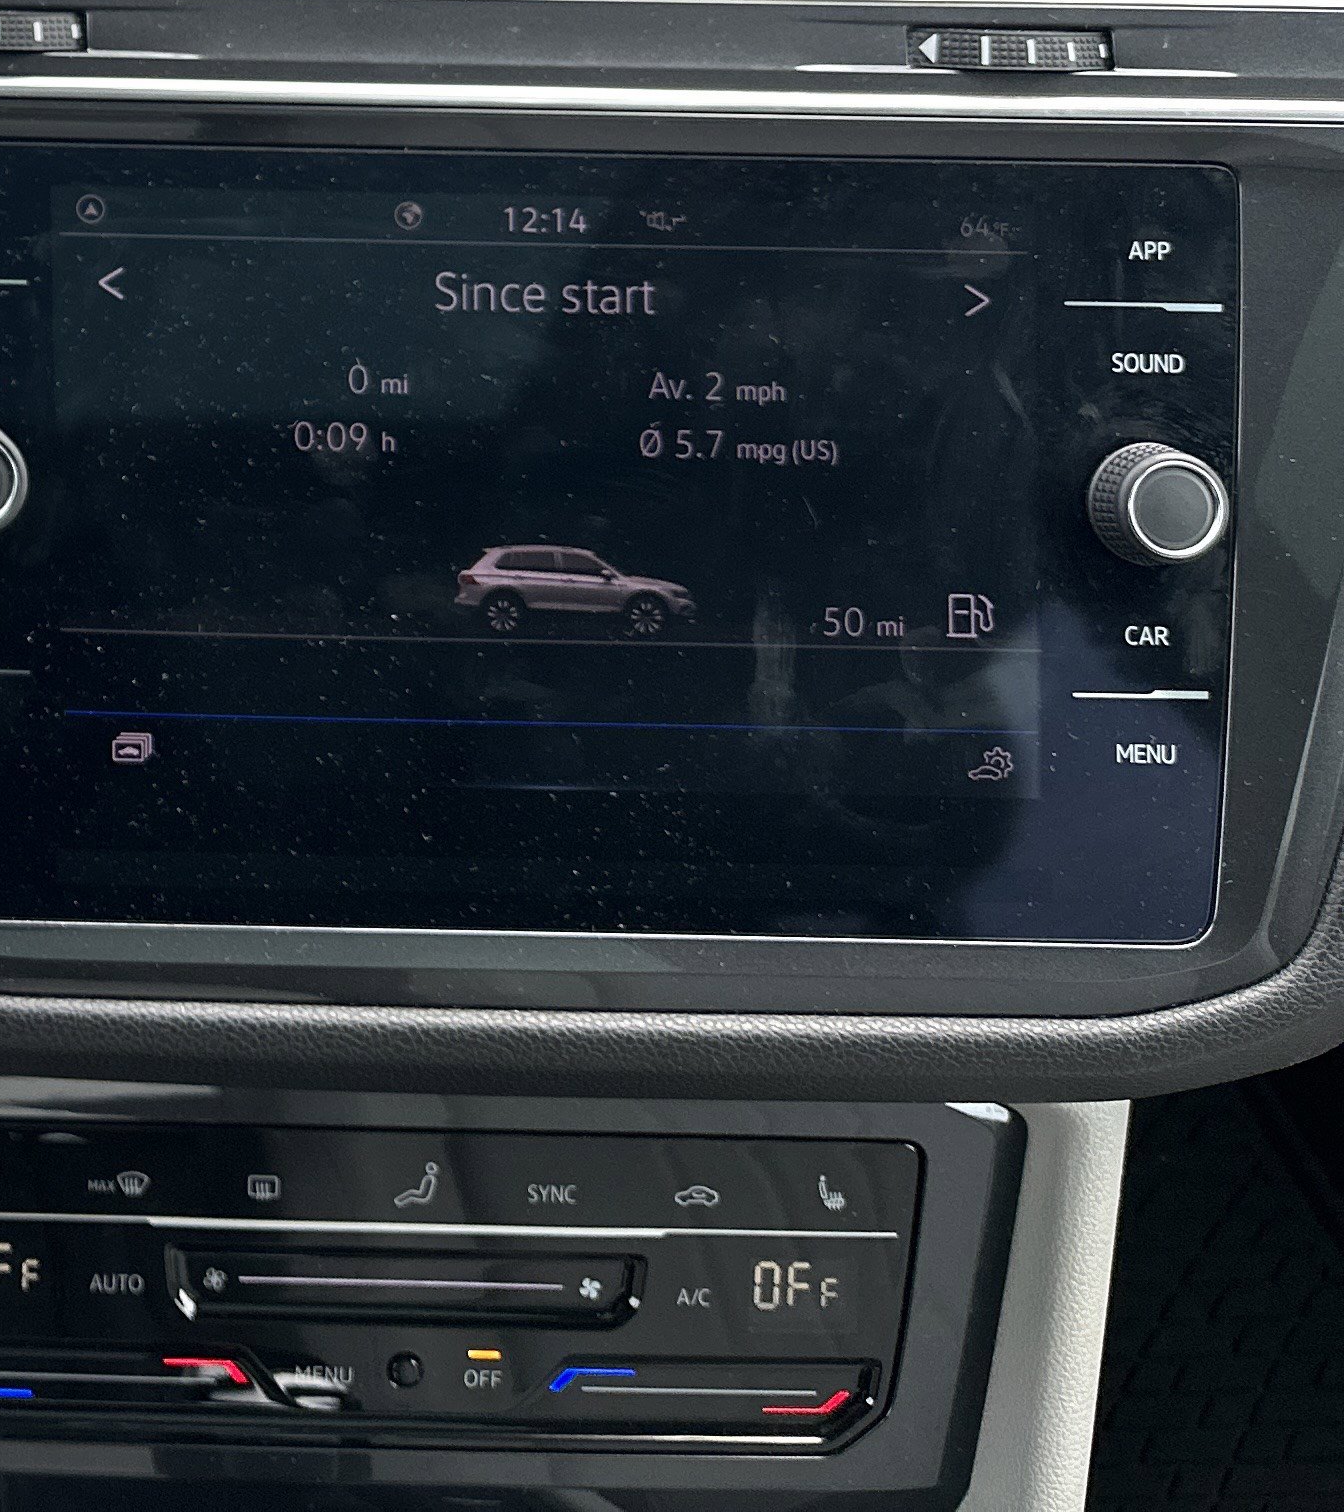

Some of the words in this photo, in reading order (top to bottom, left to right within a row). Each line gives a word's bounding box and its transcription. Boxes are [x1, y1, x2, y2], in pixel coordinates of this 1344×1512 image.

[504, 205, 589, 234] 12:14
[1128, 240, 1173, 261] APP
[434, 271, 546, 313] Since
[560, 279, 659, 316] start
[1111, 351, 1187, 375] SOUND
[348, 364, 369, 395] 0
[381, 373, 409, 395] mi
[648, 371, 693, 401] Av.
[705, 371, 725, 402] 2
[736, 381, 787, 406] mph
[294, 421, 368, 452] 0:09
[381, 431, 396, 453] h
[674, 429, 725, 459] 5.7
[736, 441, 787, 466] mpg
[792, 438, 838, 467] (US)
[823, 606, 865, 638] 50
[876, 615, 905, 638] mi
[1124, 625, 1171, 648] CAR
[1115, 742, 1178, 766] MENU
[87, 1178, 115, 1195] MAX
[526, 1182, 578, 1206] SYNC
[89, 1272, 147, 1296] AUTO
[674, 1287, 713, 1309] A/C
[462, 1367, 504, 1389] OFF
